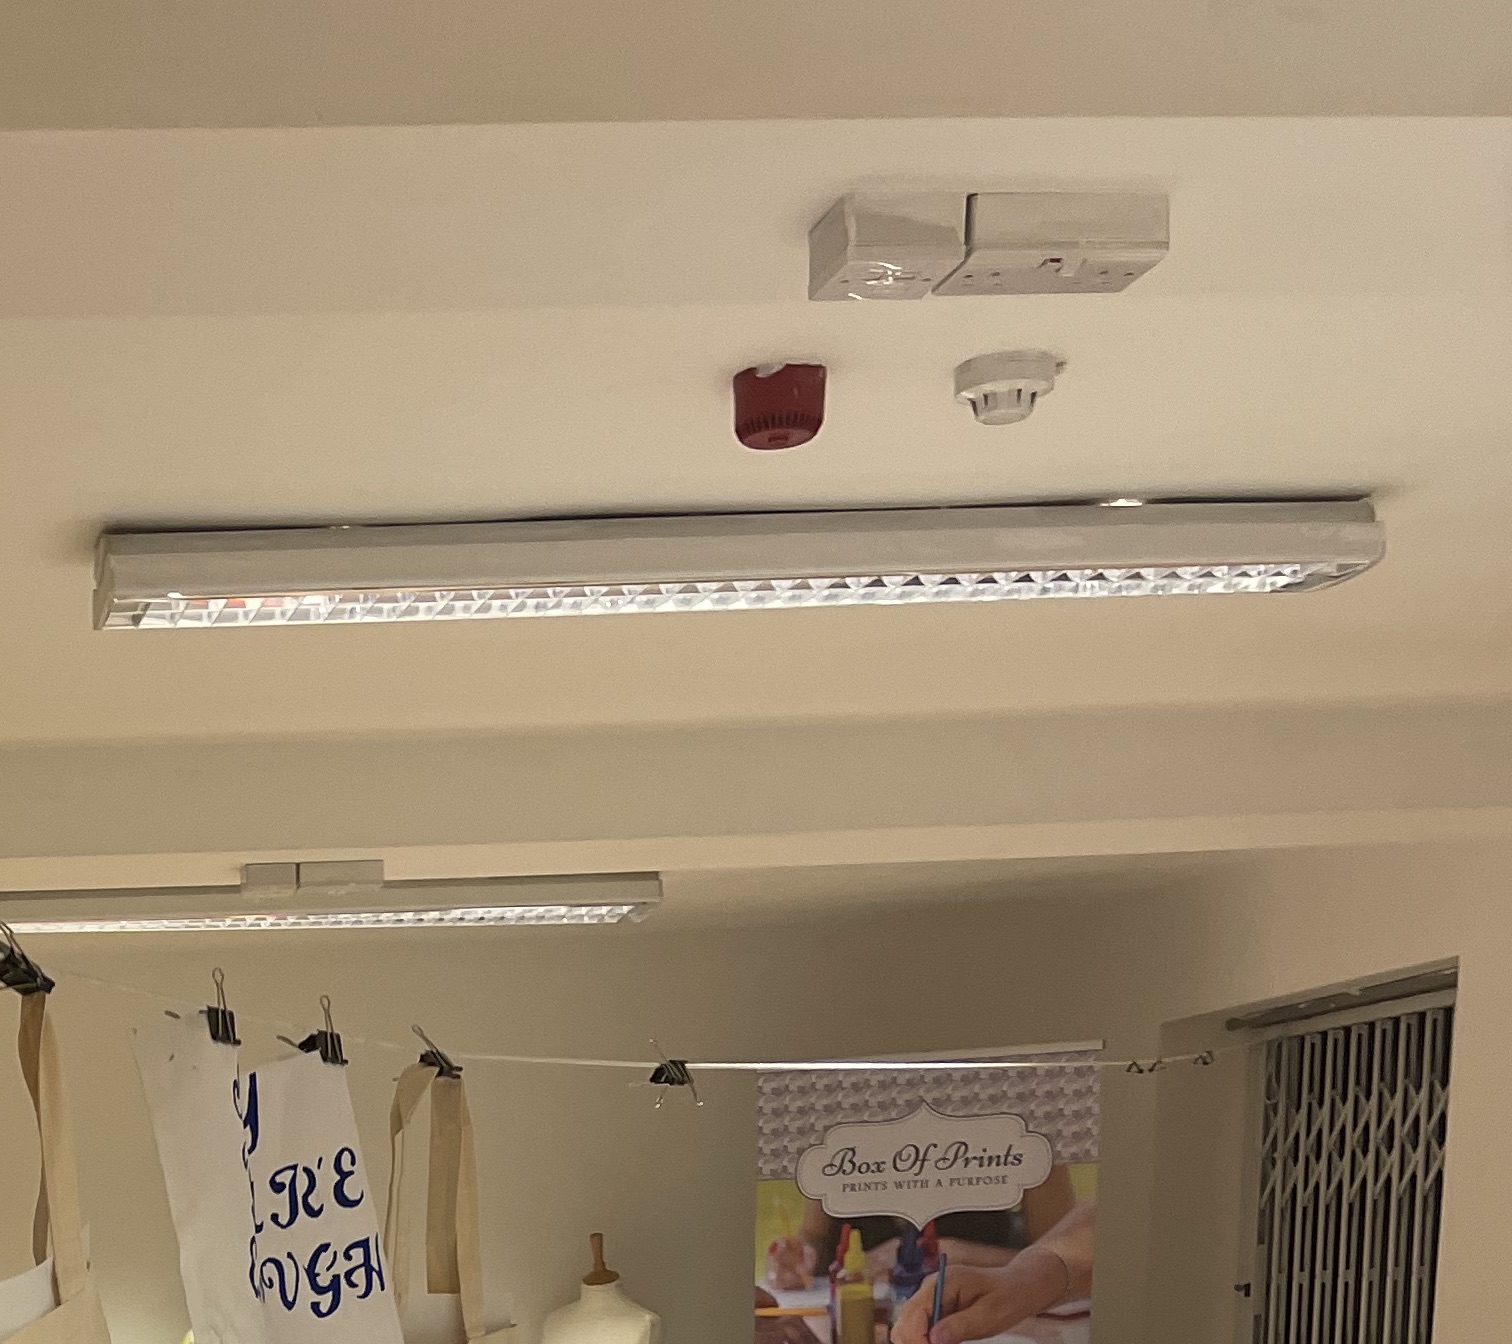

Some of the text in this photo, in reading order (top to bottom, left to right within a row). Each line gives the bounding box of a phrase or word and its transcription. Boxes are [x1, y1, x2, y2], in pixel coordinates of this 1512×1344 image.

[822, 1141, 1024, 1177] Box Of Prints
[842, 1175, 1008, 1193] PRINTS WITH A PURPOSE
